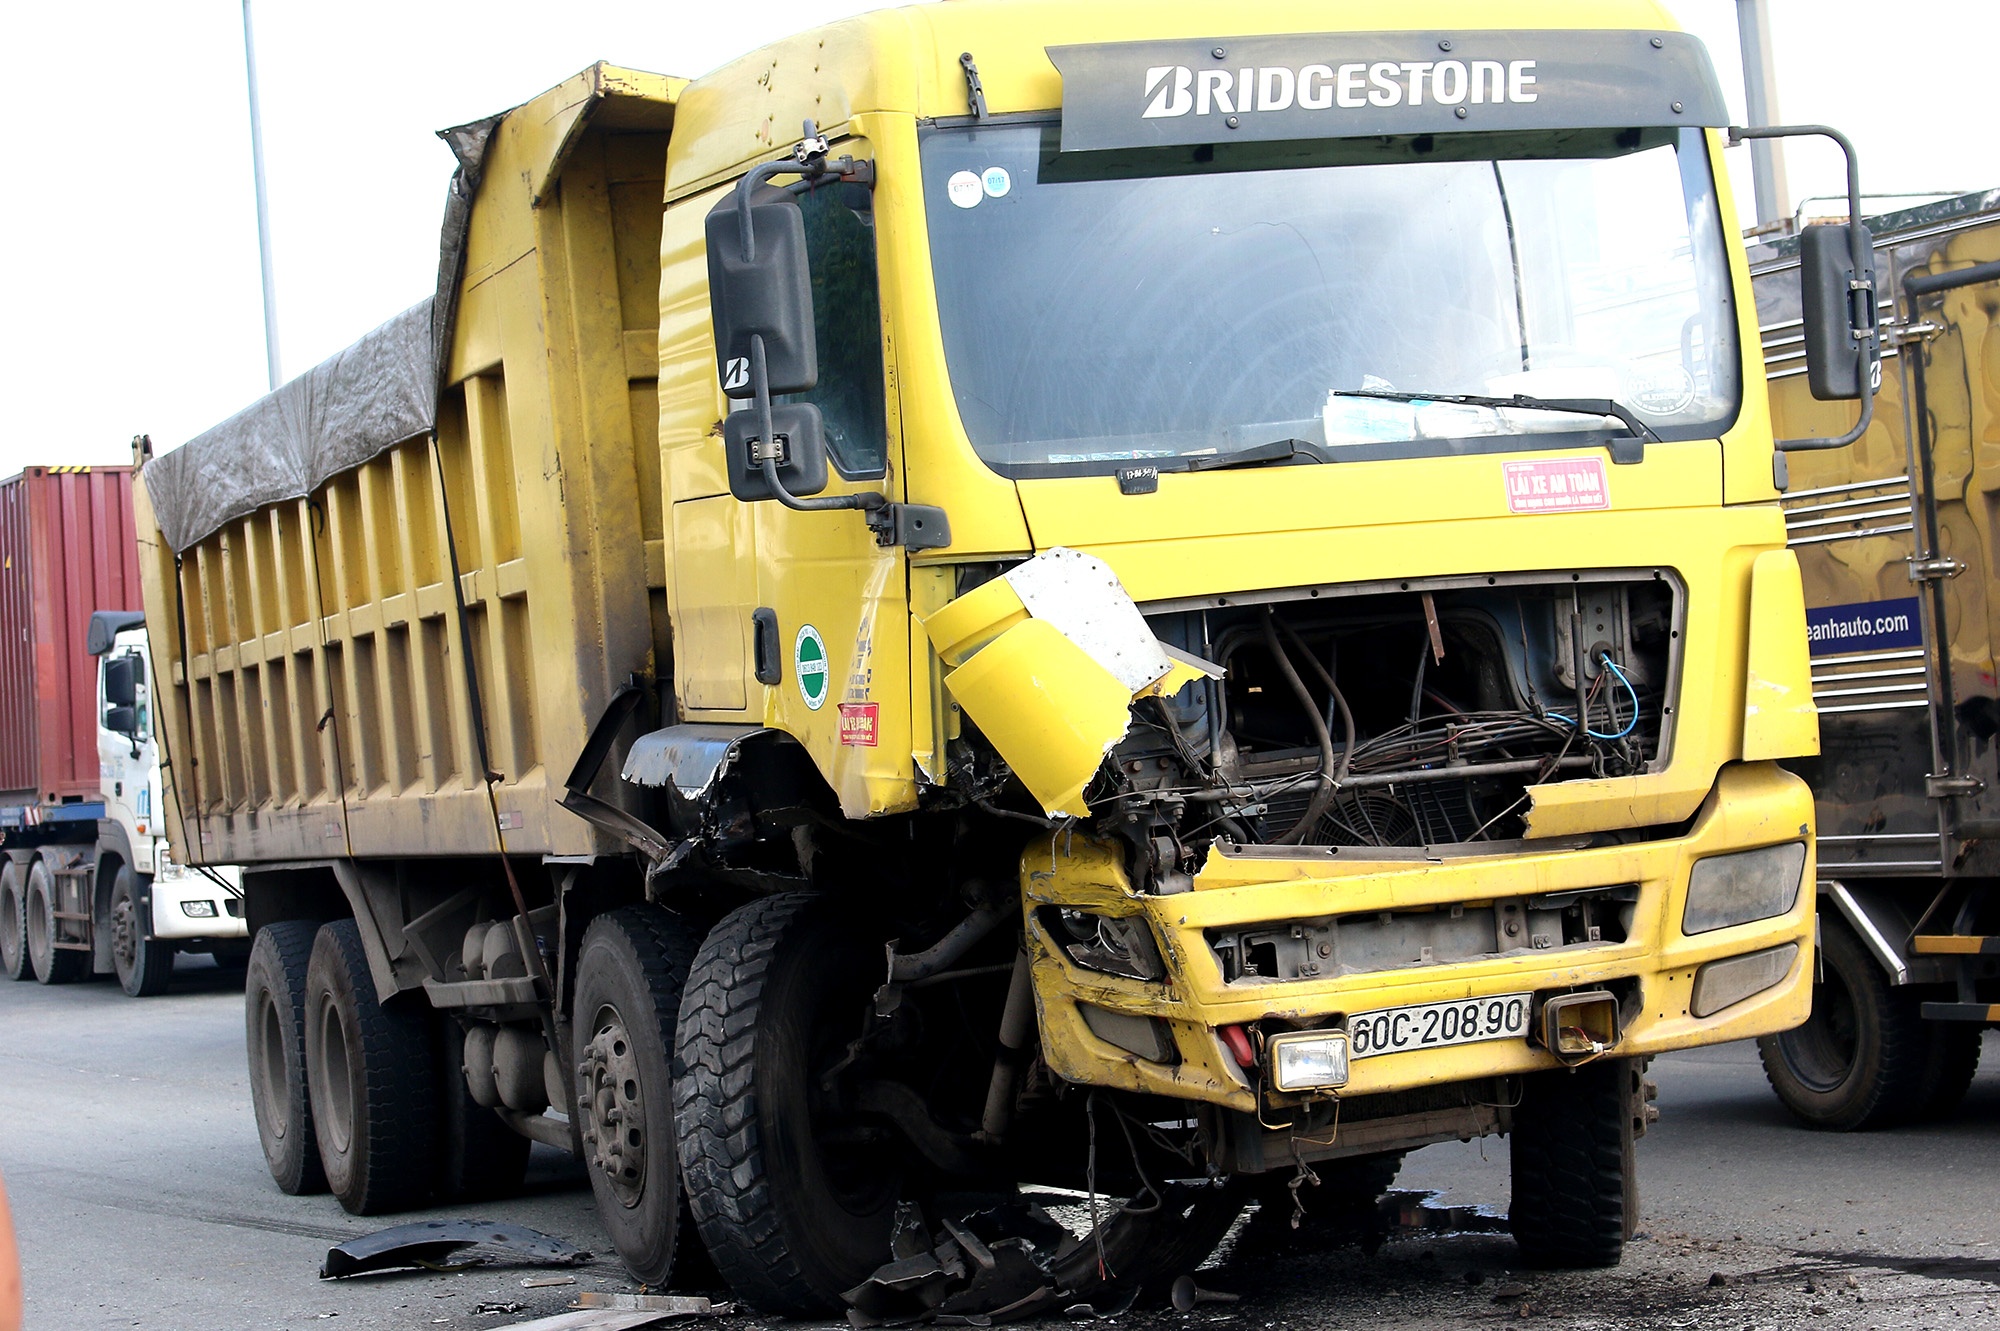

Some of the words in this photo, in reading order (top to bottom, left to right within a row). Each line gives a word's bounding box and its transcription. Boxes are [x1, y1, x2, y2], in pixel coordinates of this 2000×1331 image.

[1141, 60, 1538, 119] BRIDGESTONE
[1510, 473, 1530, 496] LÁI
[1531, 475, 1548, 494] XE
[1550, 474, 1568, 493] AN
[1568, 469, 1600, 492] TOÀN
[1352, 999, 1524, 1053] 60C-208.90
